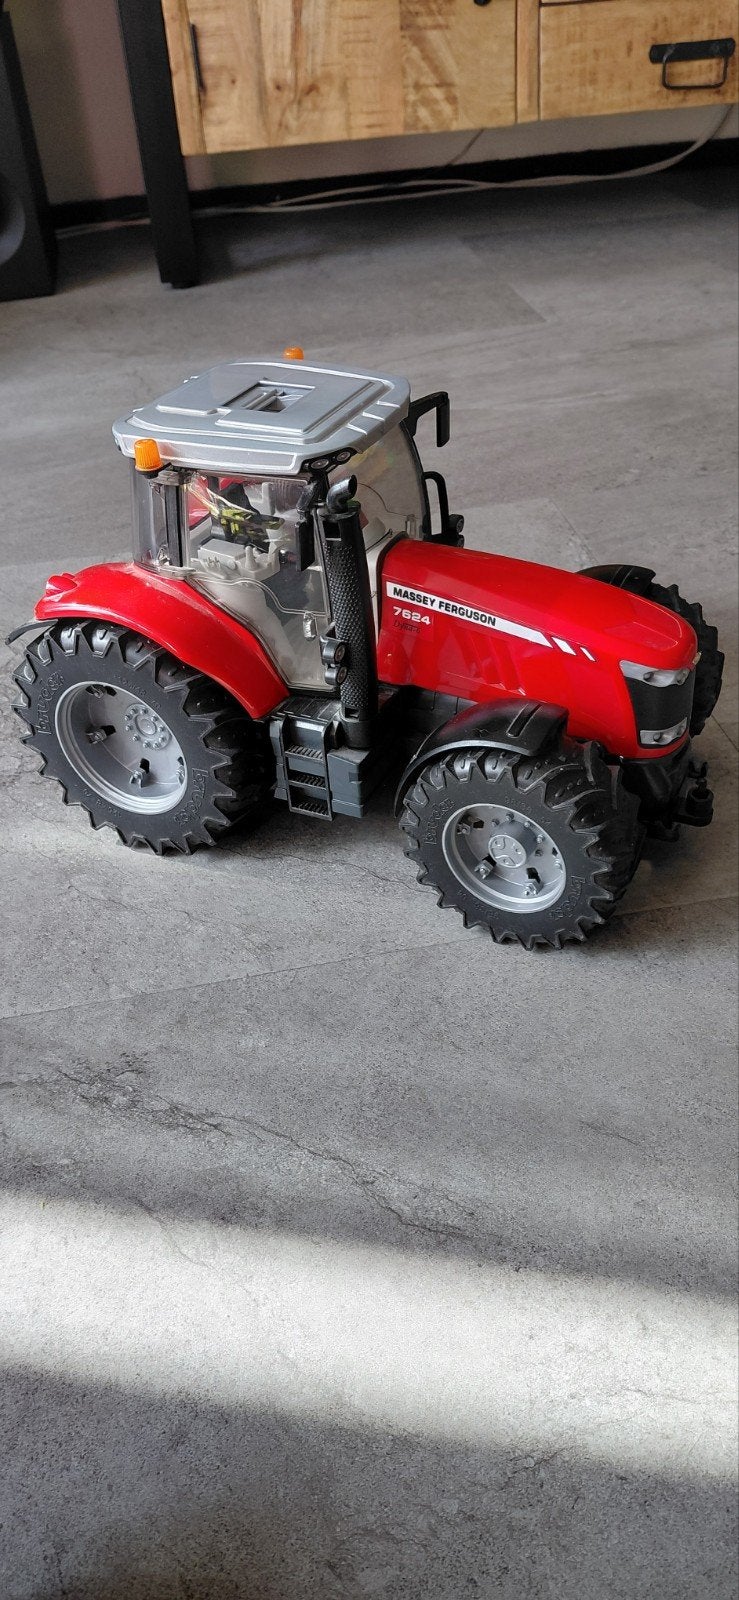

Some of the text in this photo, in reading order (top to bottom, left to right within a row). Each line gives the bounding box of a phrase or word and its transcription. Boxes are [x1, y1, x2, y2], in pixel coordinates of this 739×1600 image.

[393, 586, 496, 626] MASSEY FERGUSON
[393, 606, 431, 625] 7624
